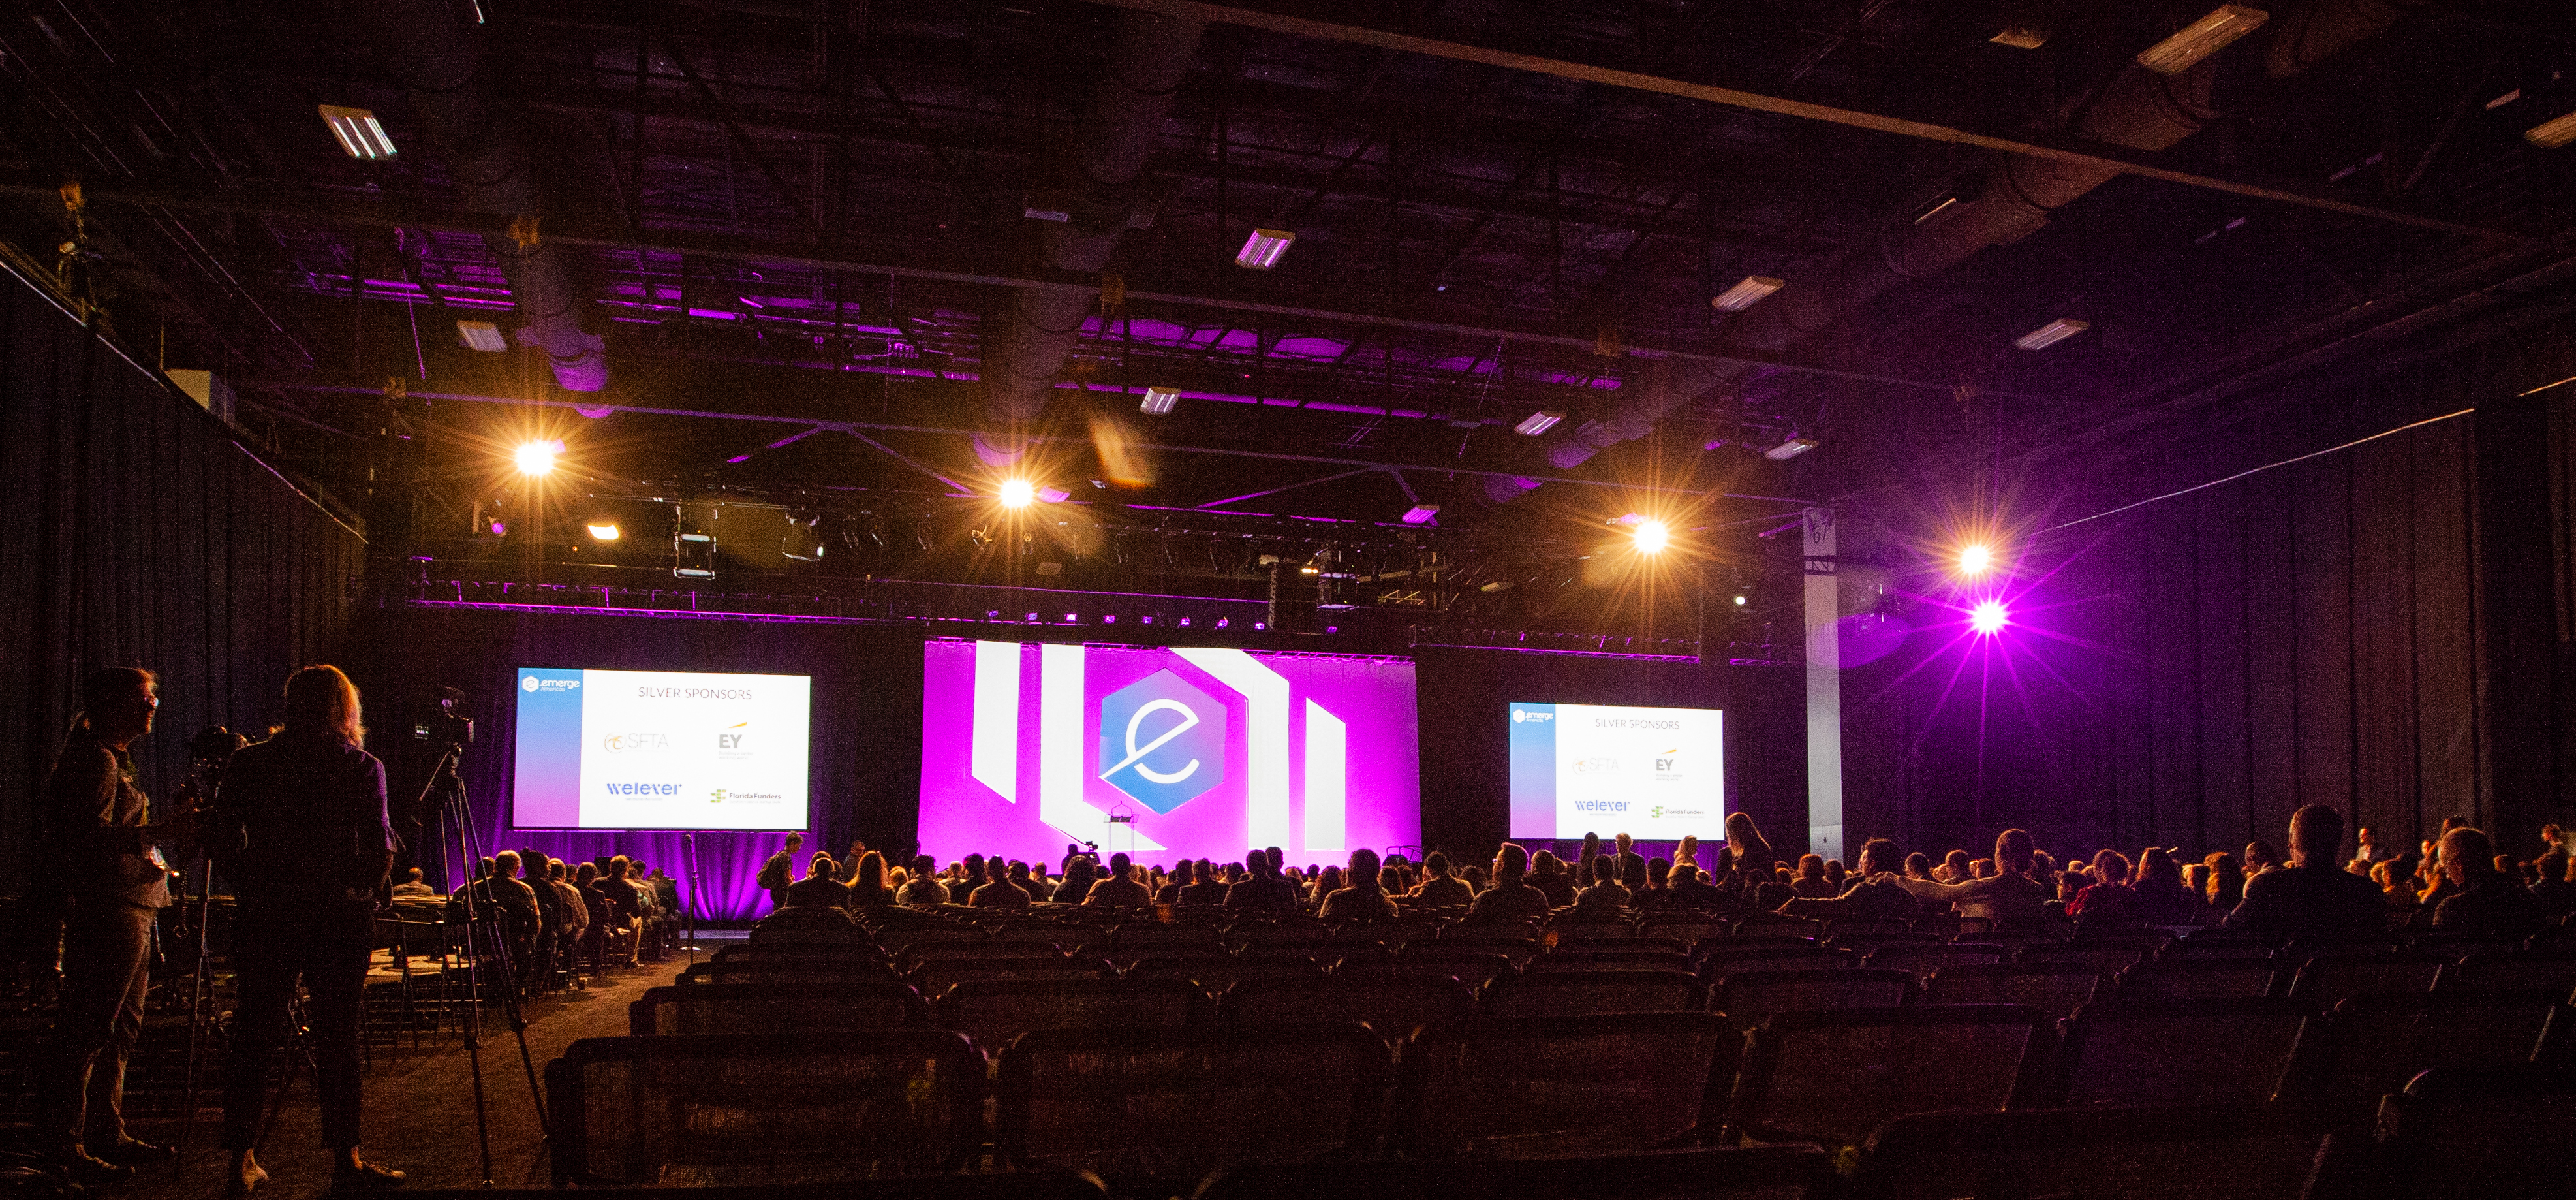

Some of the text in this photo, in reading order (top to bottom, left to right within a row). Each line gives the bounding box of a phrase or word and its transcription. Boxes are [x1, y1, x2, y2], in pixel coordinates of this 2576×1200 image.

[540, 680, 580, 689] emerge
[638, 687, 753, 700] SILVER SPONSORS
[1596, 718, 1680, 730] SILVER SPONSORS
[627, 733, 670, 749] SFTA
[719, 734, 743, 749] EY
[1098, 698, 1200, 784] e
[1589, 757, 1620, 771] SFTA
[1656, 759, 1674, 771] EY
[754, 792, 782, 800] Funders
